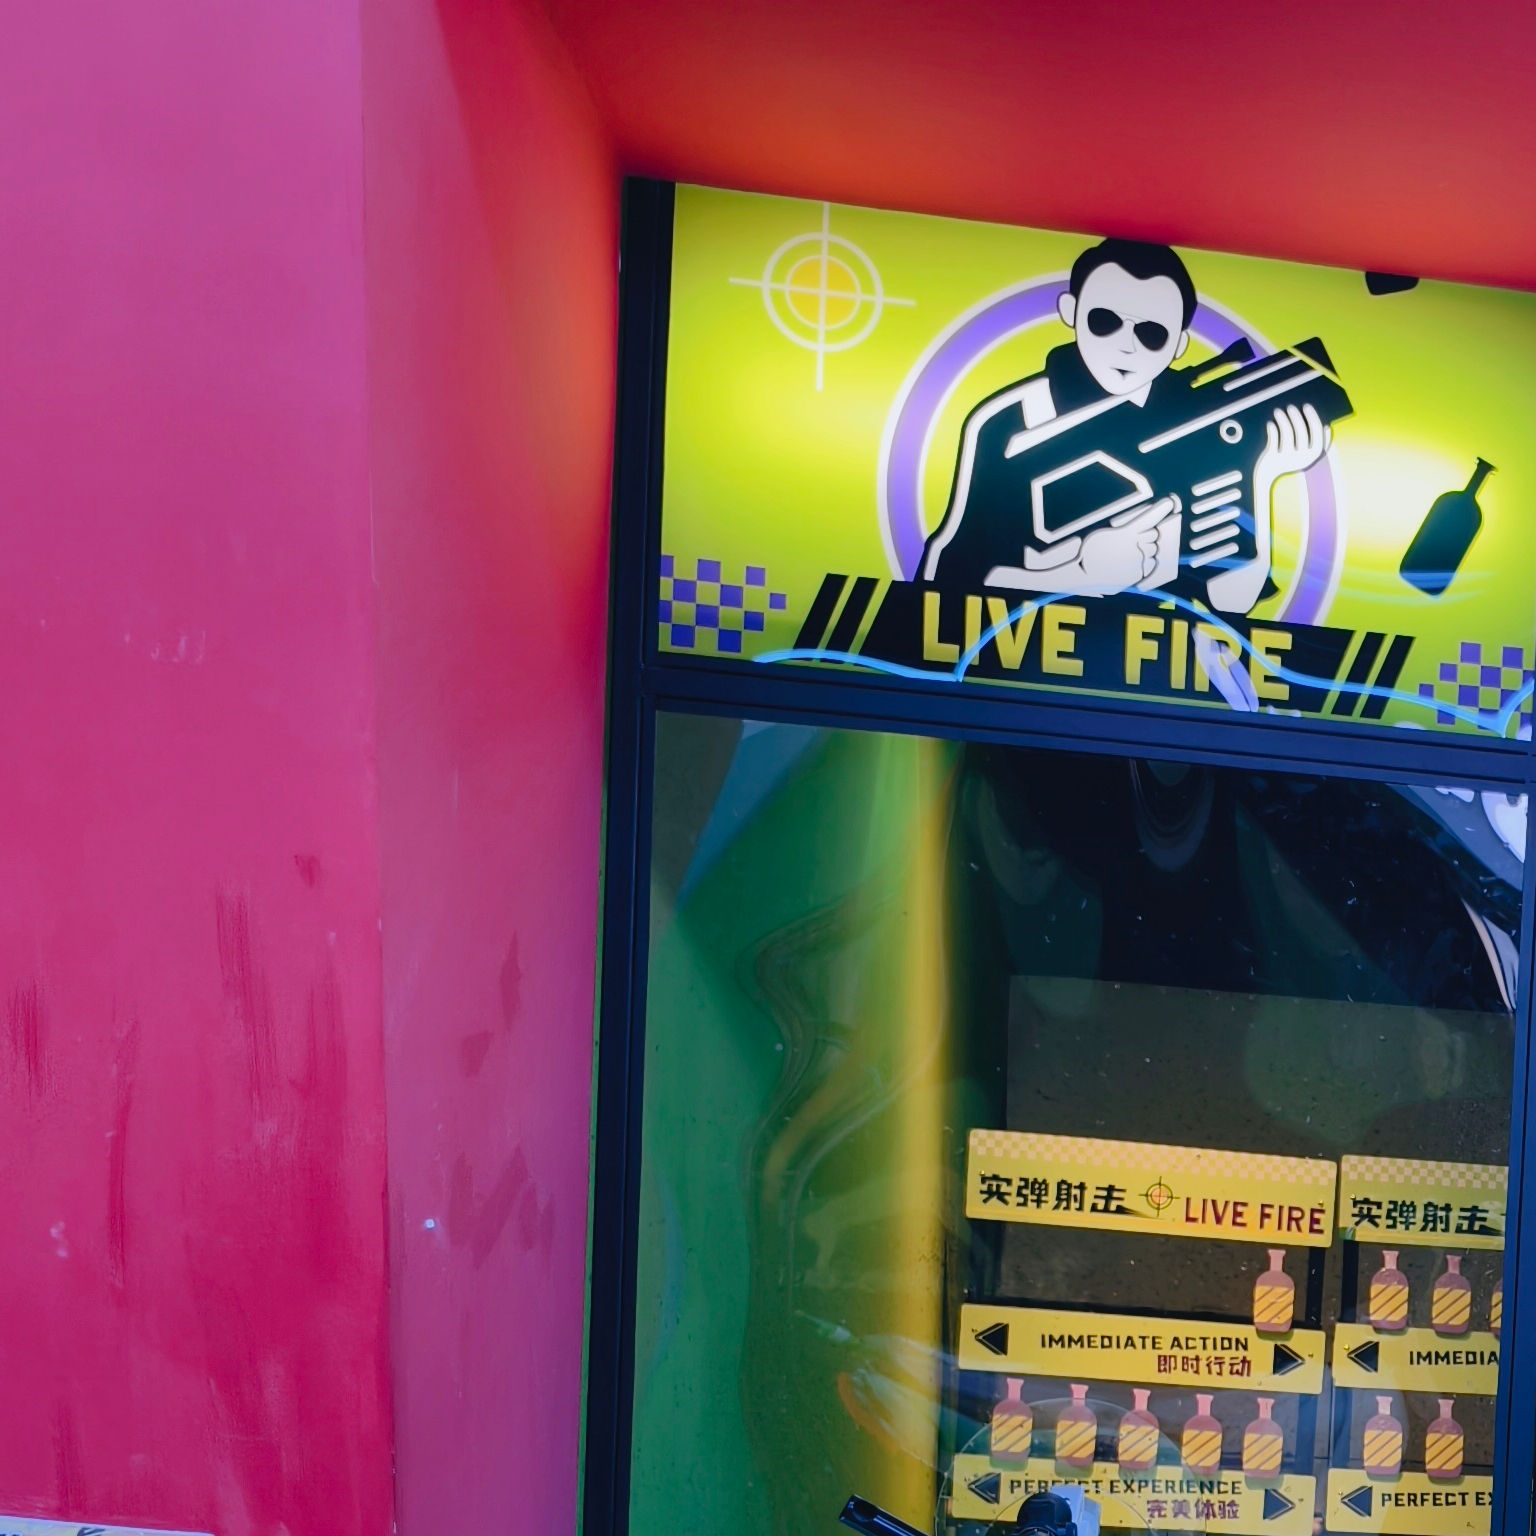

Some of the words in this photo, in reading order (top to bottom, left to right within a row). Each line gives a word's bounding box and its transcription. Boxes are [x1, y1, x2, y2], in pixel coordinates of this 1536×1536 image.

[922, 590, 1085, 677] LIVE
[1124, 613, 1293, 701] FIRE
[979, 1173, 1128, 1214] 实弹射击
[1185, 1196, 1249, 1228] LIVE
[1259, 1203, 1326, 1235] FIRE
[1351, 1197, 1490, 1235] 实弹射击
[1040, 1333, 1163, 1350] IMMEDIATE
[1170, 1335, 1249, 1352] ACTION
[1157, 1353, 1252, 1378] 即时行动
[1409, 1349, 1498, 1366] IMMEDIA
[1109, 1478, 1243, 1496] EXPERIENCE
[1146, 1499, 1241, 1520] 完美体验
[1381, 1491, 1470, 1507] PERFECT
